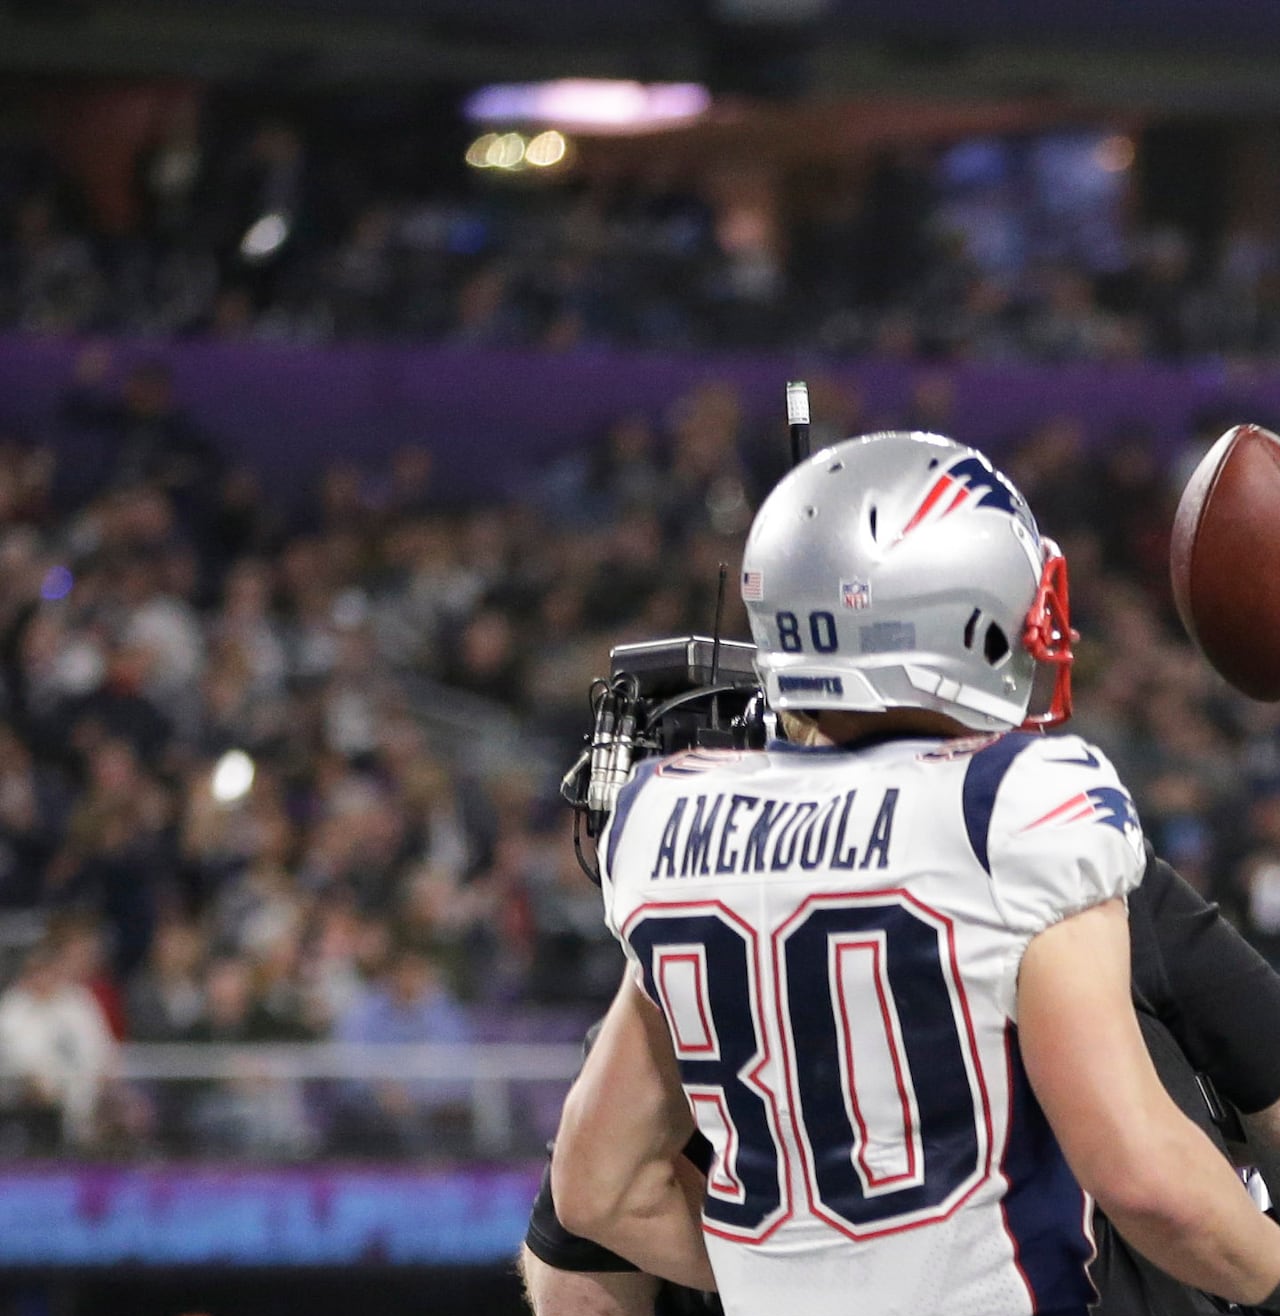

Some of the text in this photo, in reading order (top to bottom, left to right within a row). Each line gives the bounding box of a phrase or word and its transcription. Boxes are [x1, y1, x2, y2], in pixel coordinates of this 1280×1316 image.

[776, 611, 839, 653] 80
[651, 787, 900, 880] AMENDOLA
[621, 888, 993, 1244] 80
